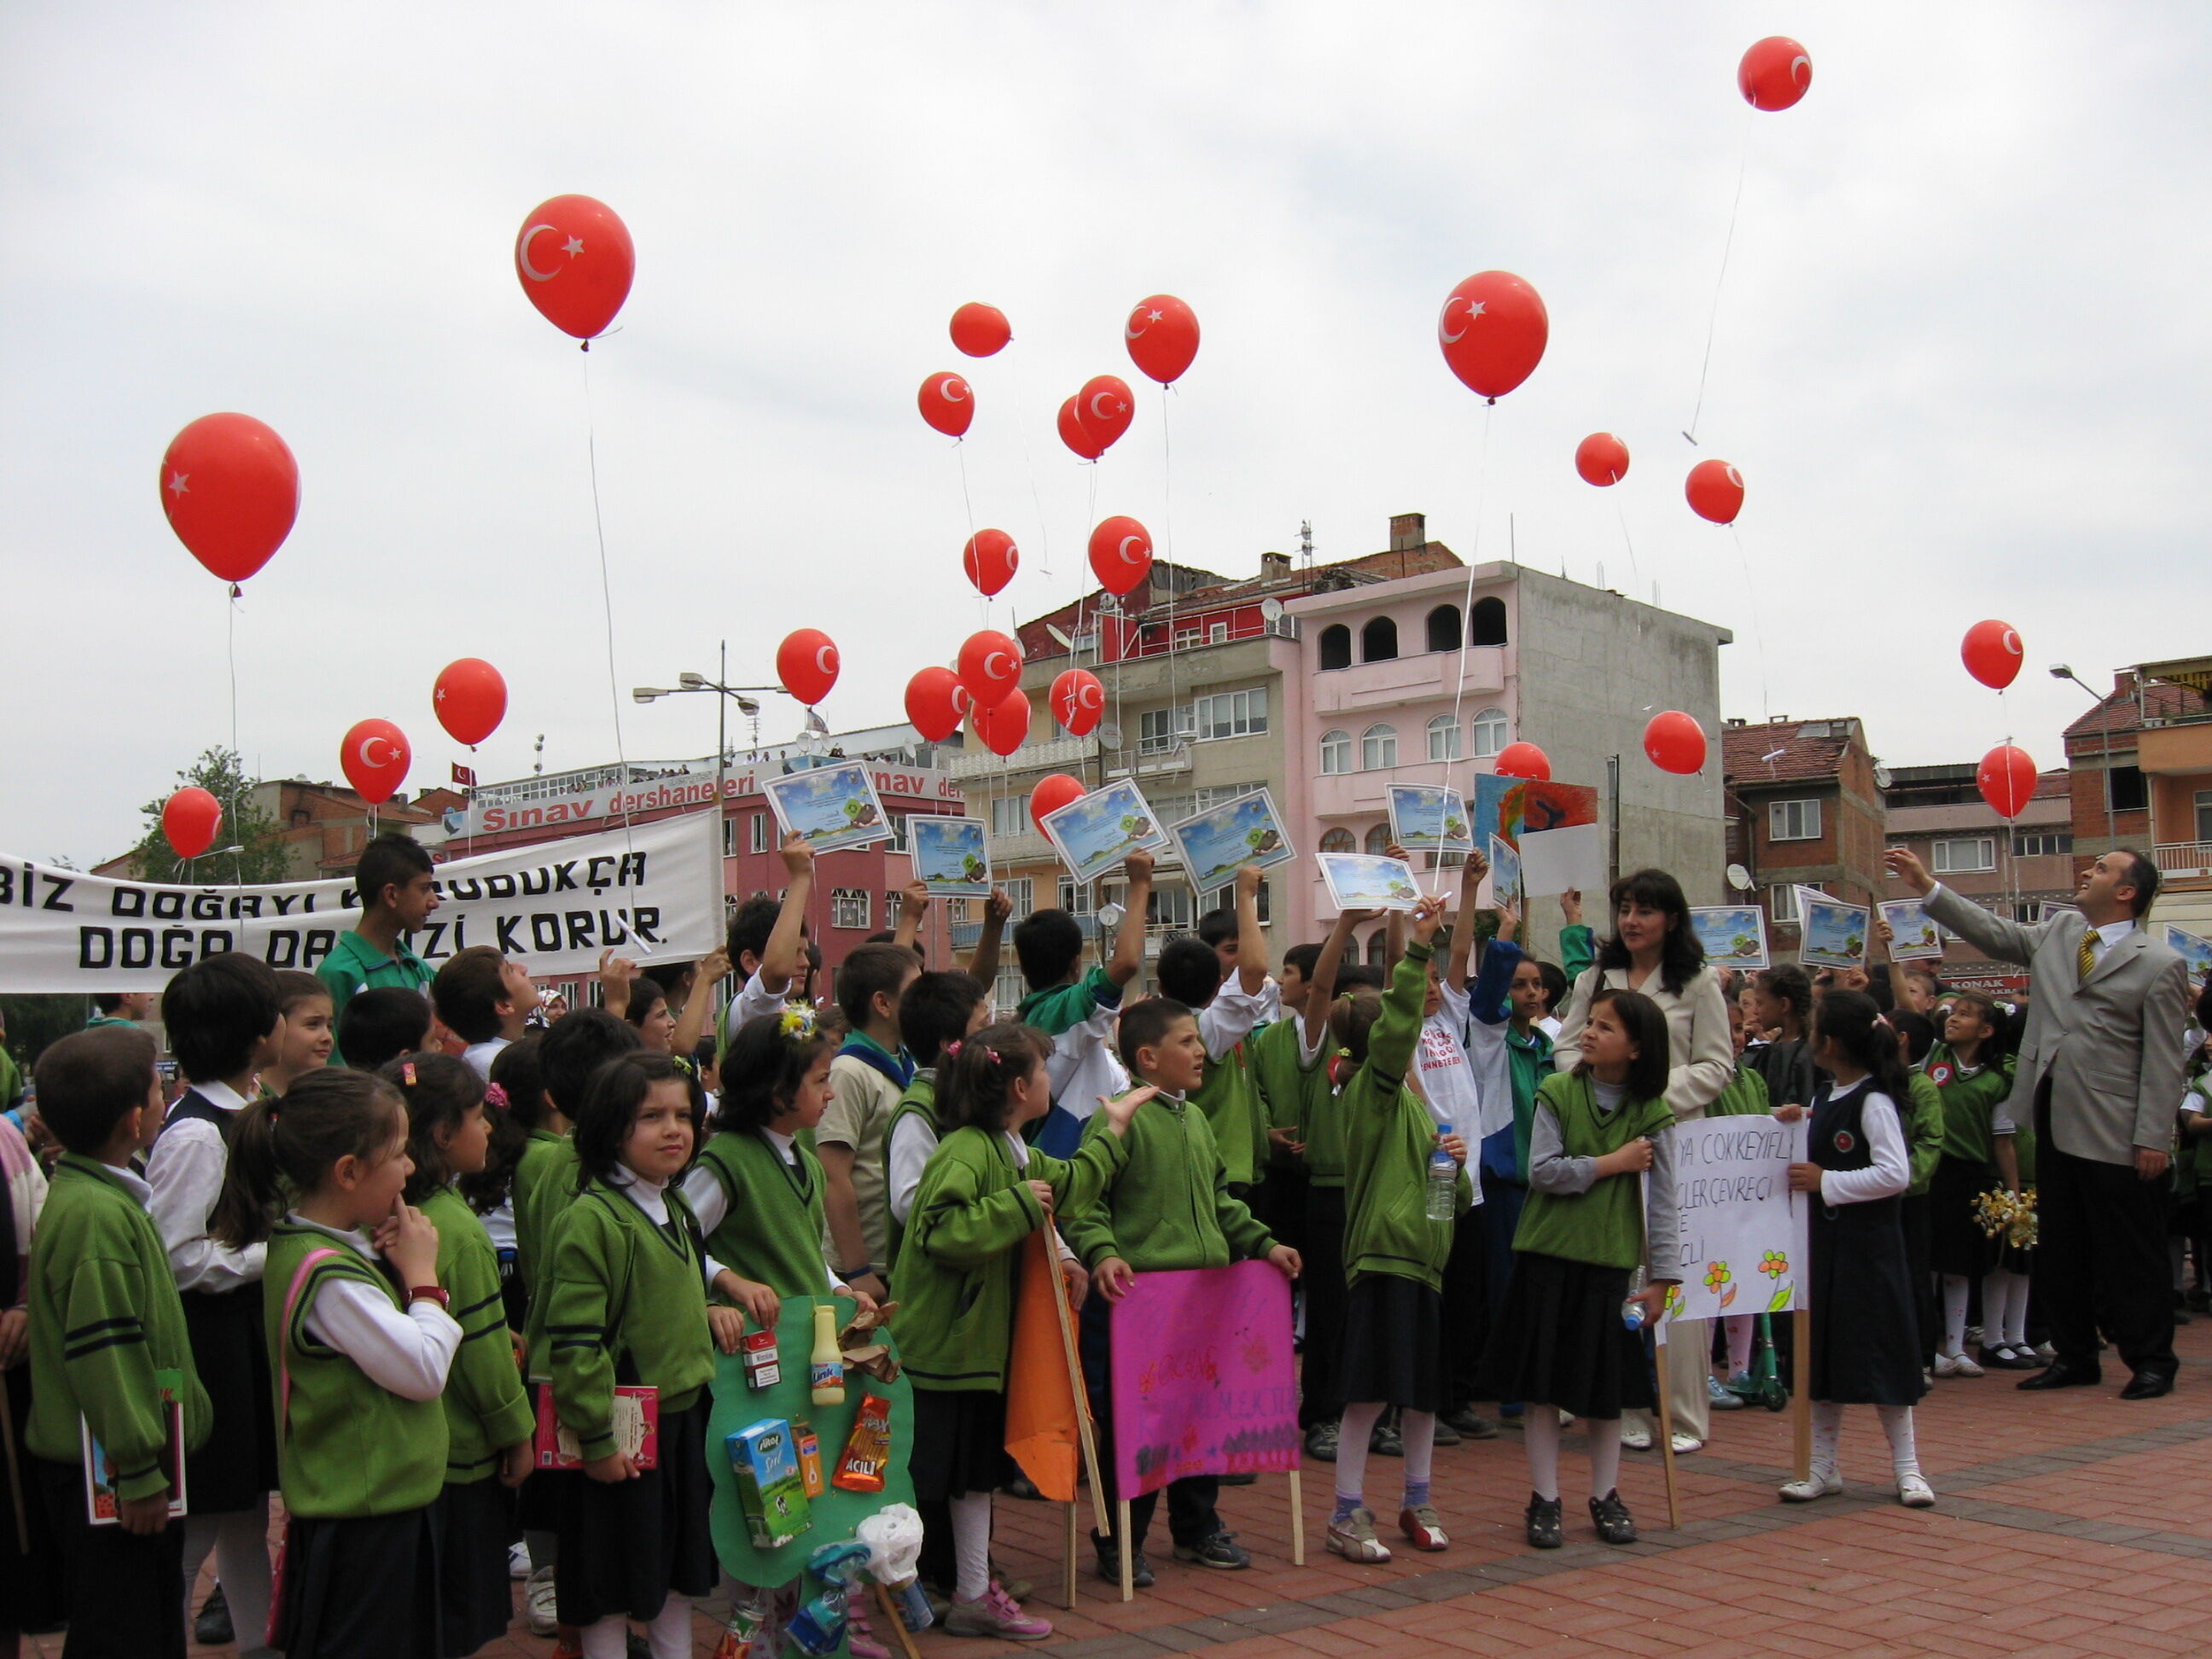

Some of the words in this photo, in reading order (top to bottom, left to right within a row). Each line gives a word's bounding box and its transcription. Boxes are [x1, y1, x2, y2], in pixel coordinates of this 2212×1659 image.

[483, 800, 594, 831] Sınav
[609, 771, 754, 812] dershaneleri
[112, 887, 316, 920] DOĞAYI
[79, 924, 233, 969] DOĞA
[266, 929, 335, 969] DA
[497, 906, 668, 955] KORUR.
[1951, 979, 2005, 990] KONAK
